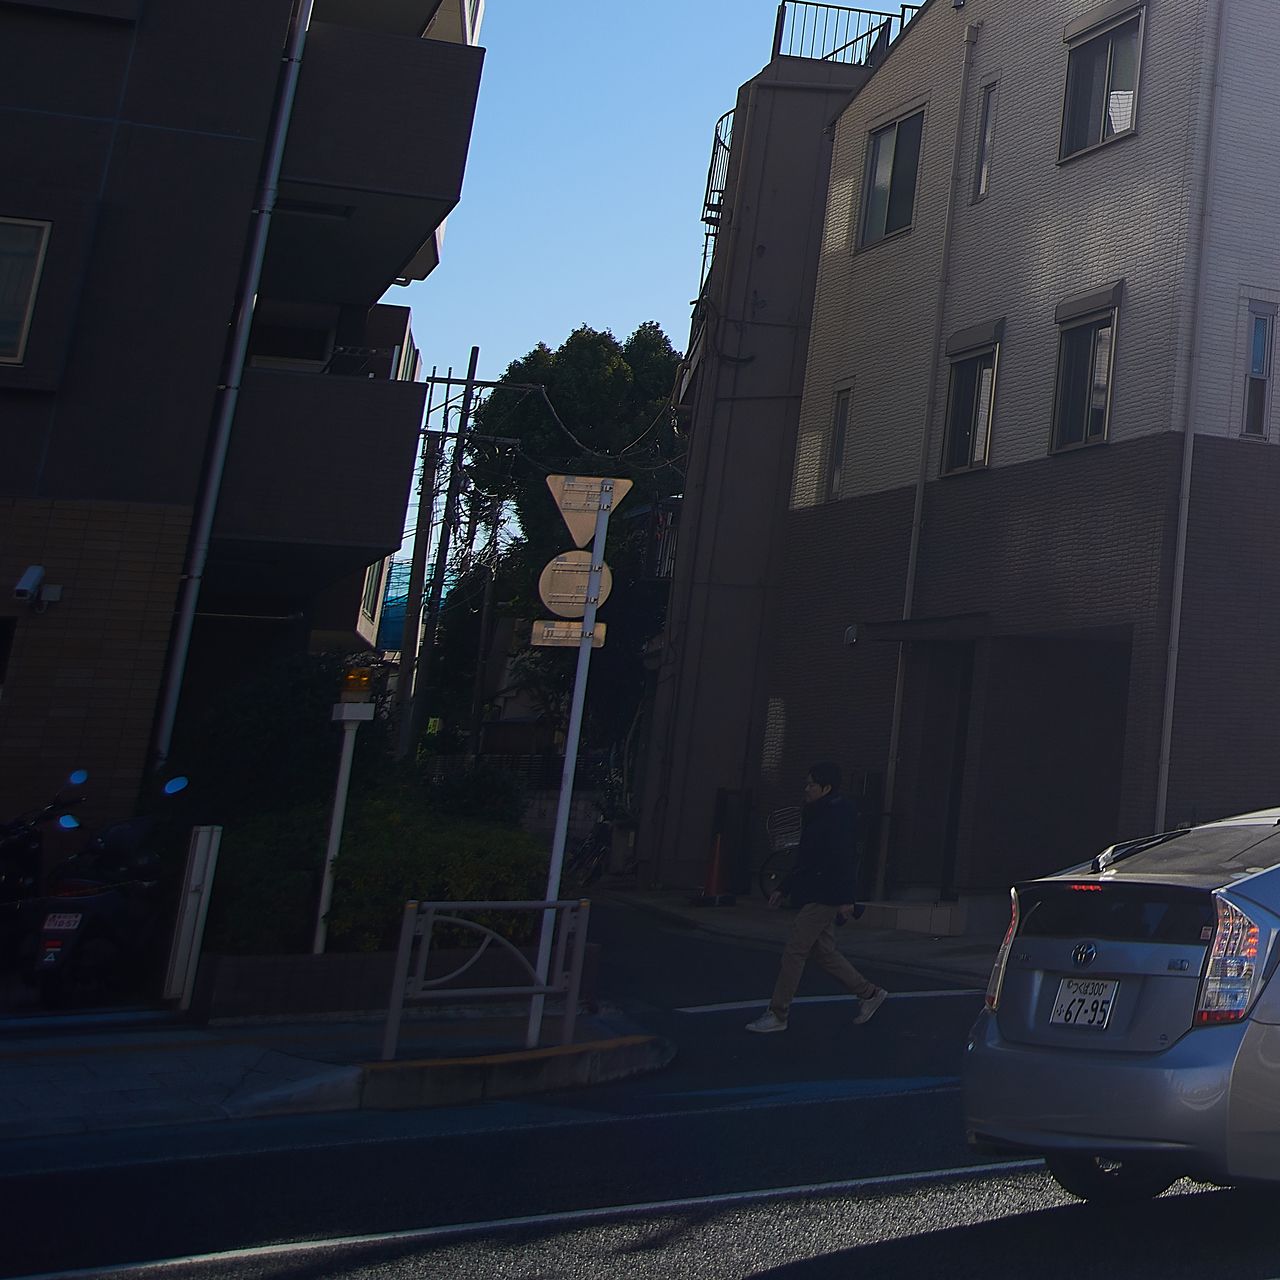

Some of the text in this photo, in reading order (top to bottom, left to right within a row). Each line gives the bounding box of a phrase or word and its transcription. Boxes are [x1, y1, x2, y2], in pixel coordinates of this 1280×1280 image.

[1073, 981, 1104, 996] つくば300
[1064, 998, 1110, 1024] 67-95
